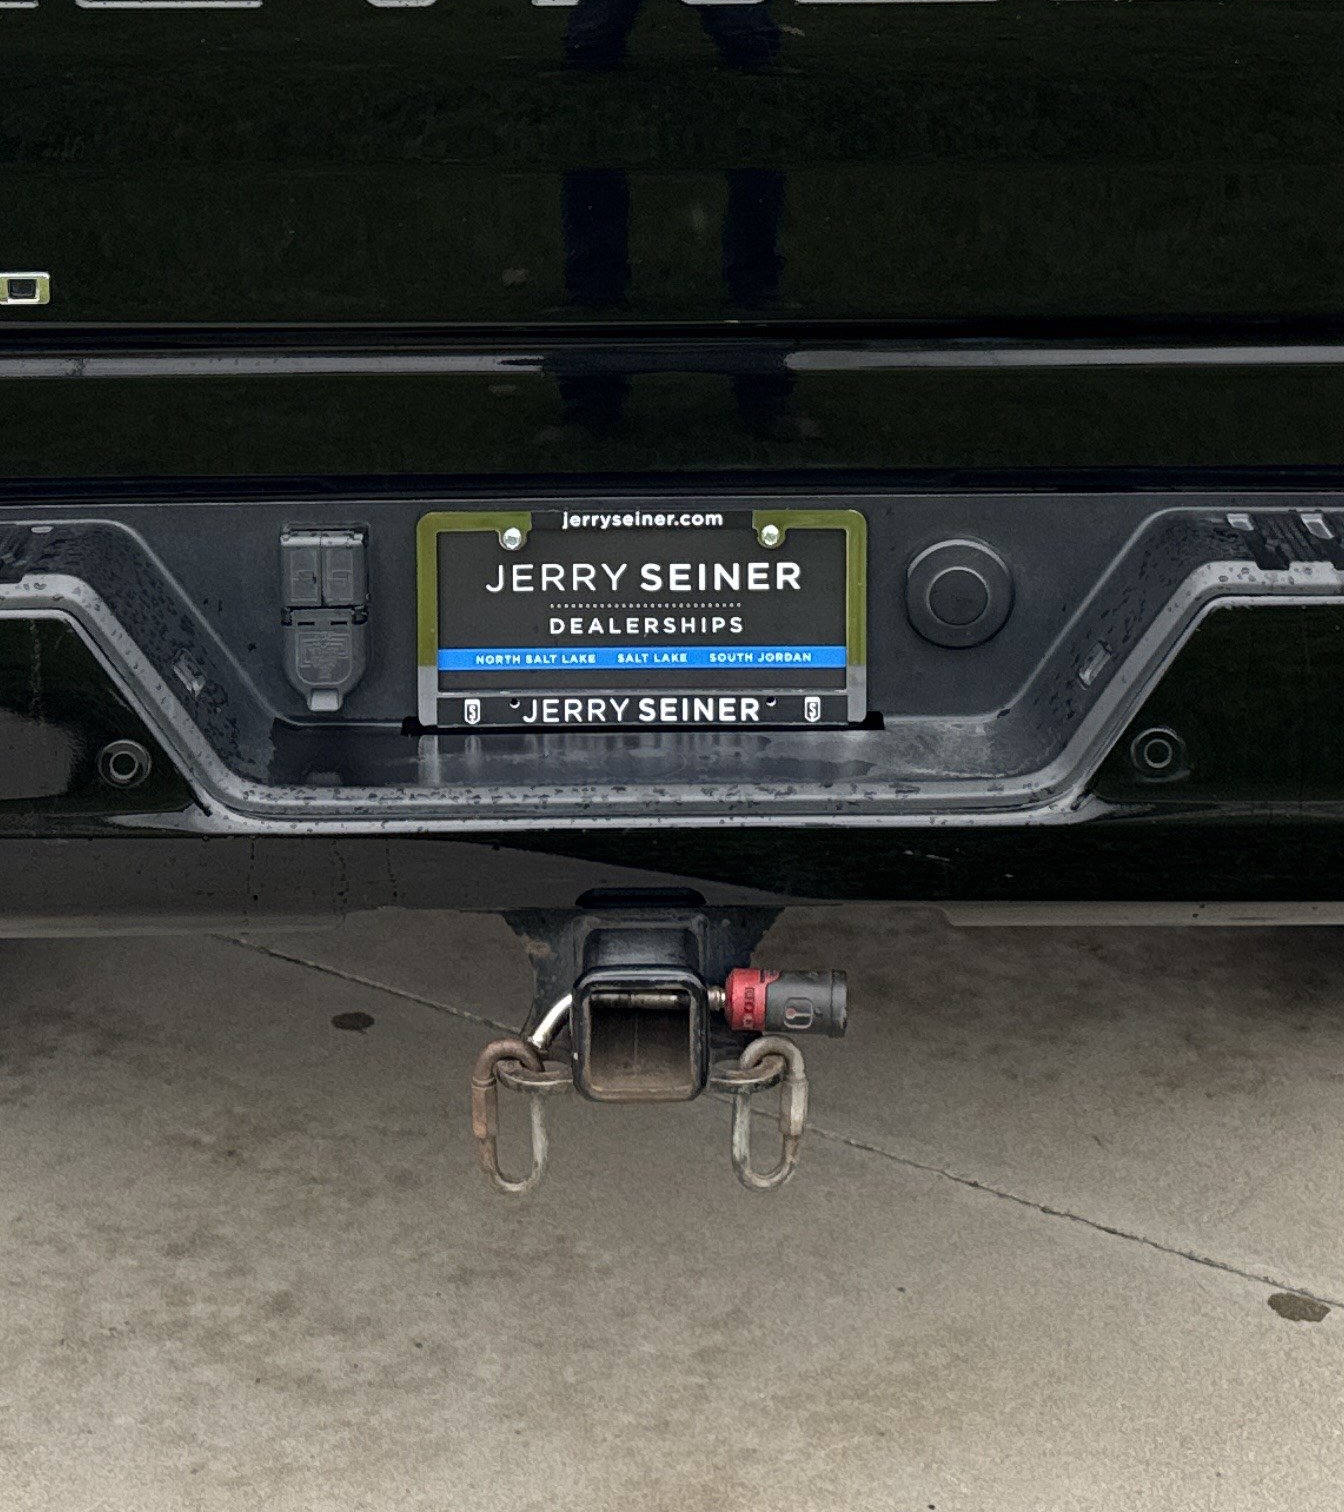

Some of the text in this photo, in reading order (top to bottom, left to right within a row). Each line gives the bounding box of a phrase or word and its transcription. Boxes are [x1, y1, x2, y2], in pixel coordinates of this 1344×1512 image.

[561, 510, 724, 530] jerryseiner.com
[485, 561, 801, 593] JERRY SEINER
[549, 616, 744, 636] DEALERSHIPS
[475, 653, 596, 665] NORTH SALT LAKE
[617, 652, 688, 664] SALT LAKE
[709, 651, 812, 664] SOUTH JORDAN
[522, 697, 760, 724] JERRY SEINER
